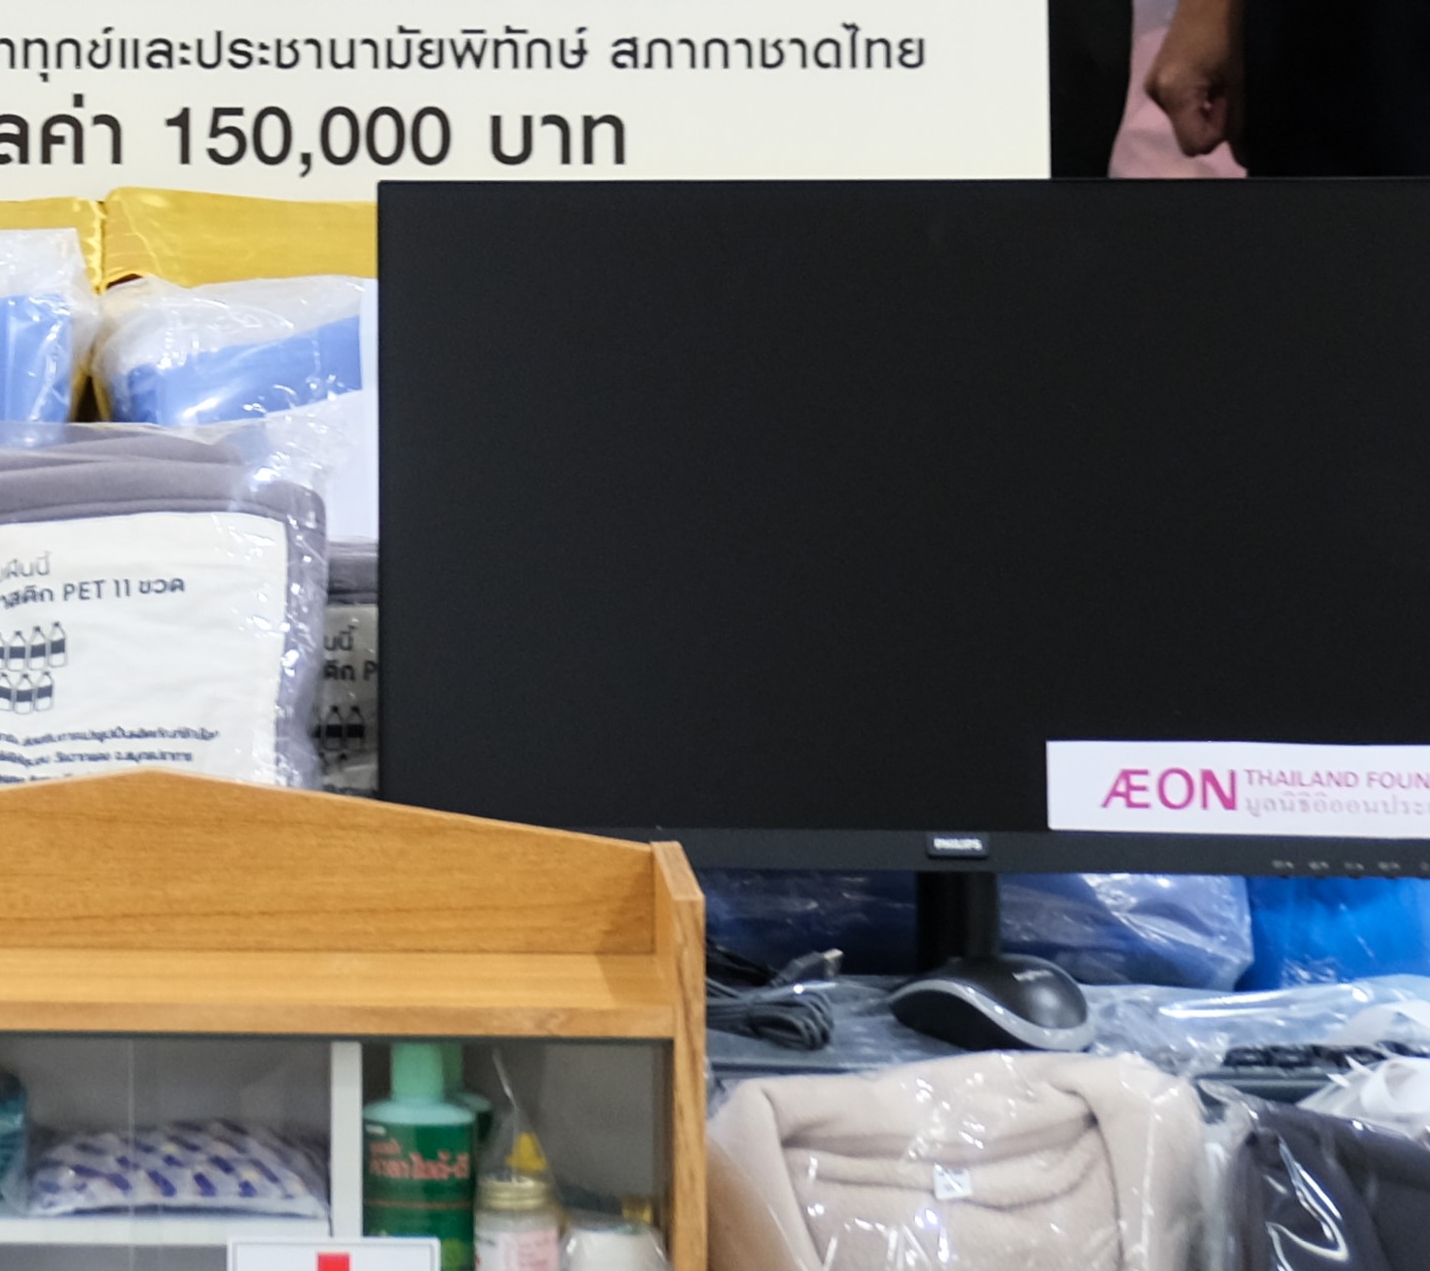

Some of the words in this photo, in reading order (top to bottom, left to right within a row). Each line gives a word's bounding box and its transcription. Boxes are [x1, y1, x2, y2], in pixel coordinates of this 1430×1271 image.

[610, 22, 925, 70] สภากาชาดไทย
[164, 105, 452, 177] 150,000
[489, 111, 628, 166] บาท
[62, 579, 106, 603] PET
[113, 578, 131, 599] 11
[139, 576, 186, 595] ขวด
[1244, 768, 1360, 788] THAILAND
